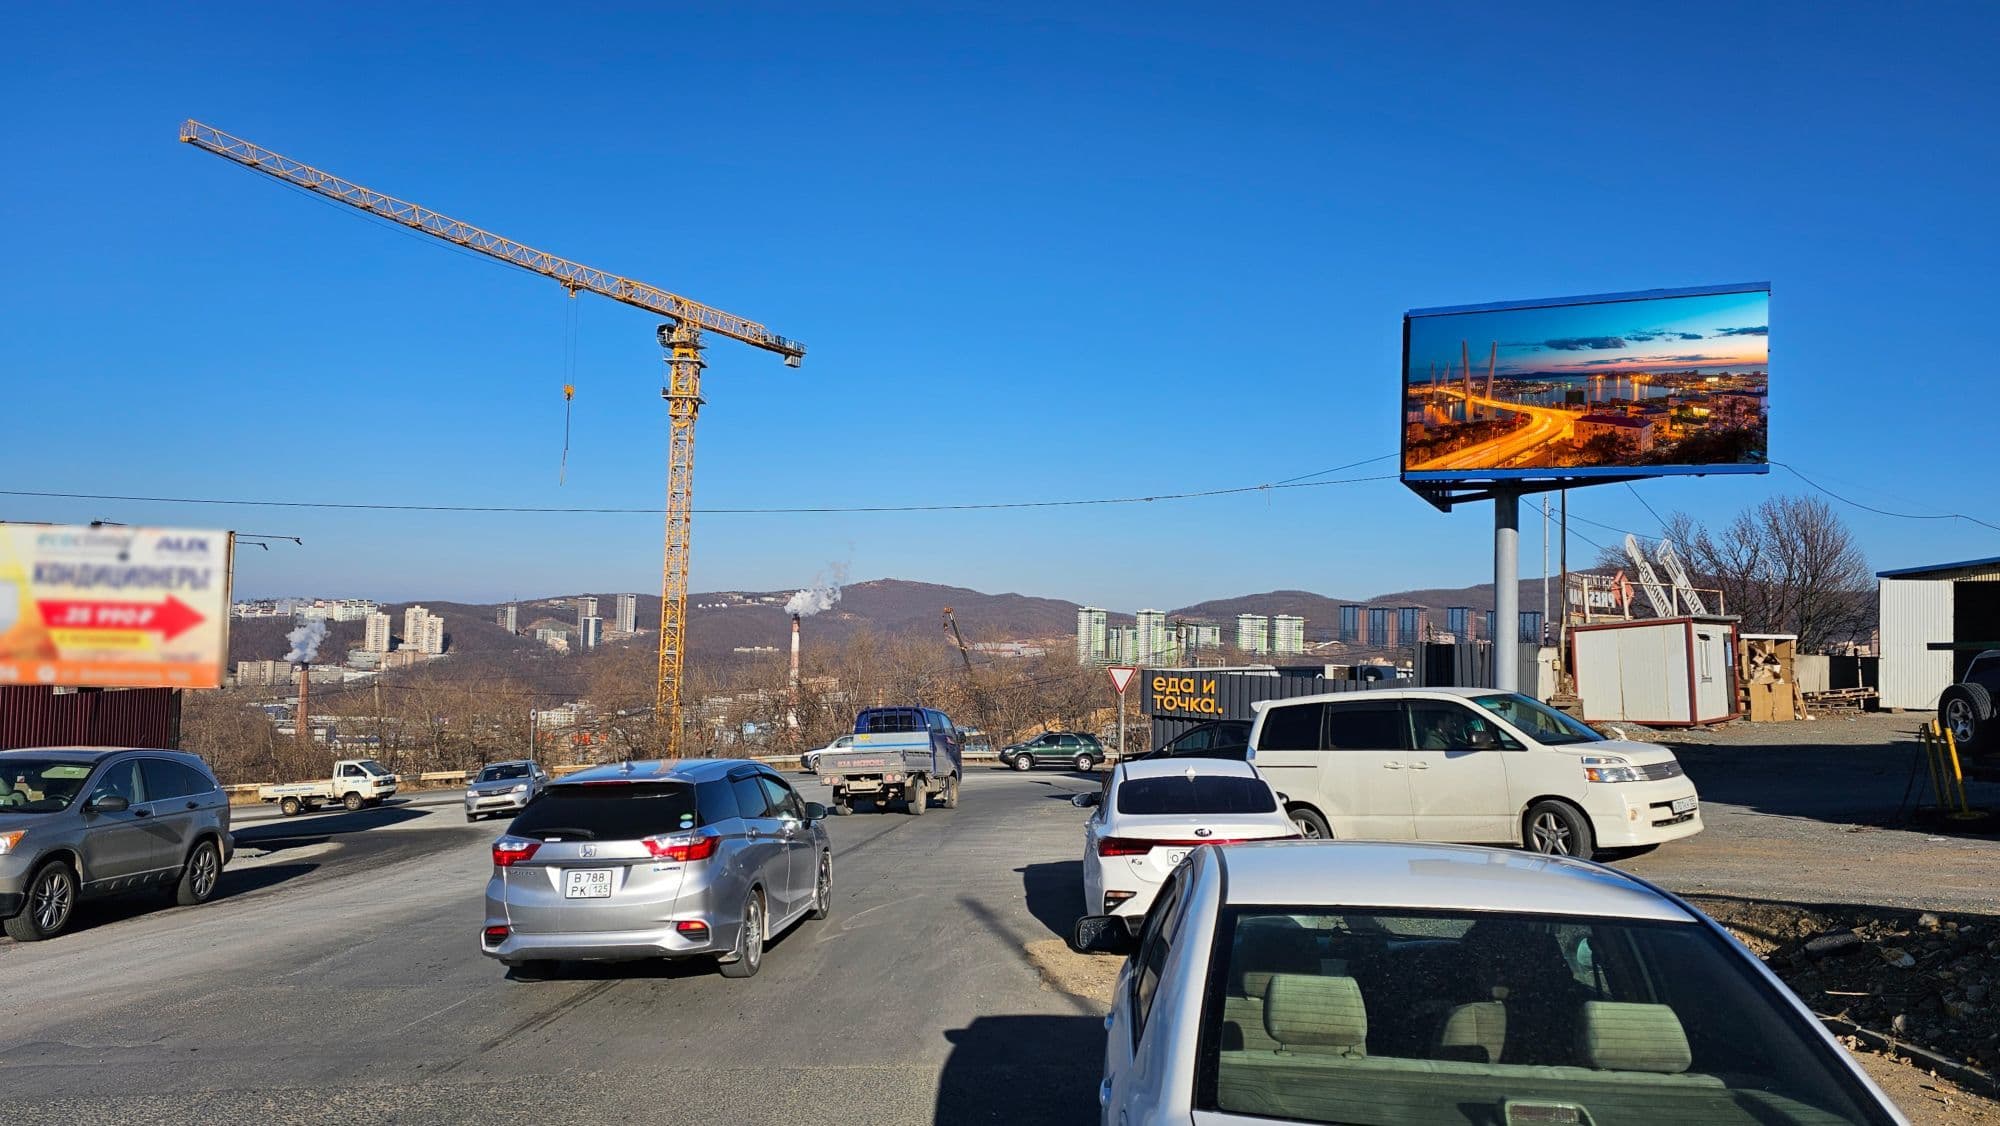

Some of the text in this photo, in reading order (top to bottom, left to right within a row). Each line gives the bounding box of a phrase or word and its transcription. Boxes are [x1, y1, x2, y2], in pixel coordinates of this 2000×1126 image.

[1153, 676, 1216, 695] еда и
[1153, 694, 1224, 714] точка.
[585, 873, 605, 883] 788
[571, 886, 587, 896] РК
[593, 885, 608, 894] 125
